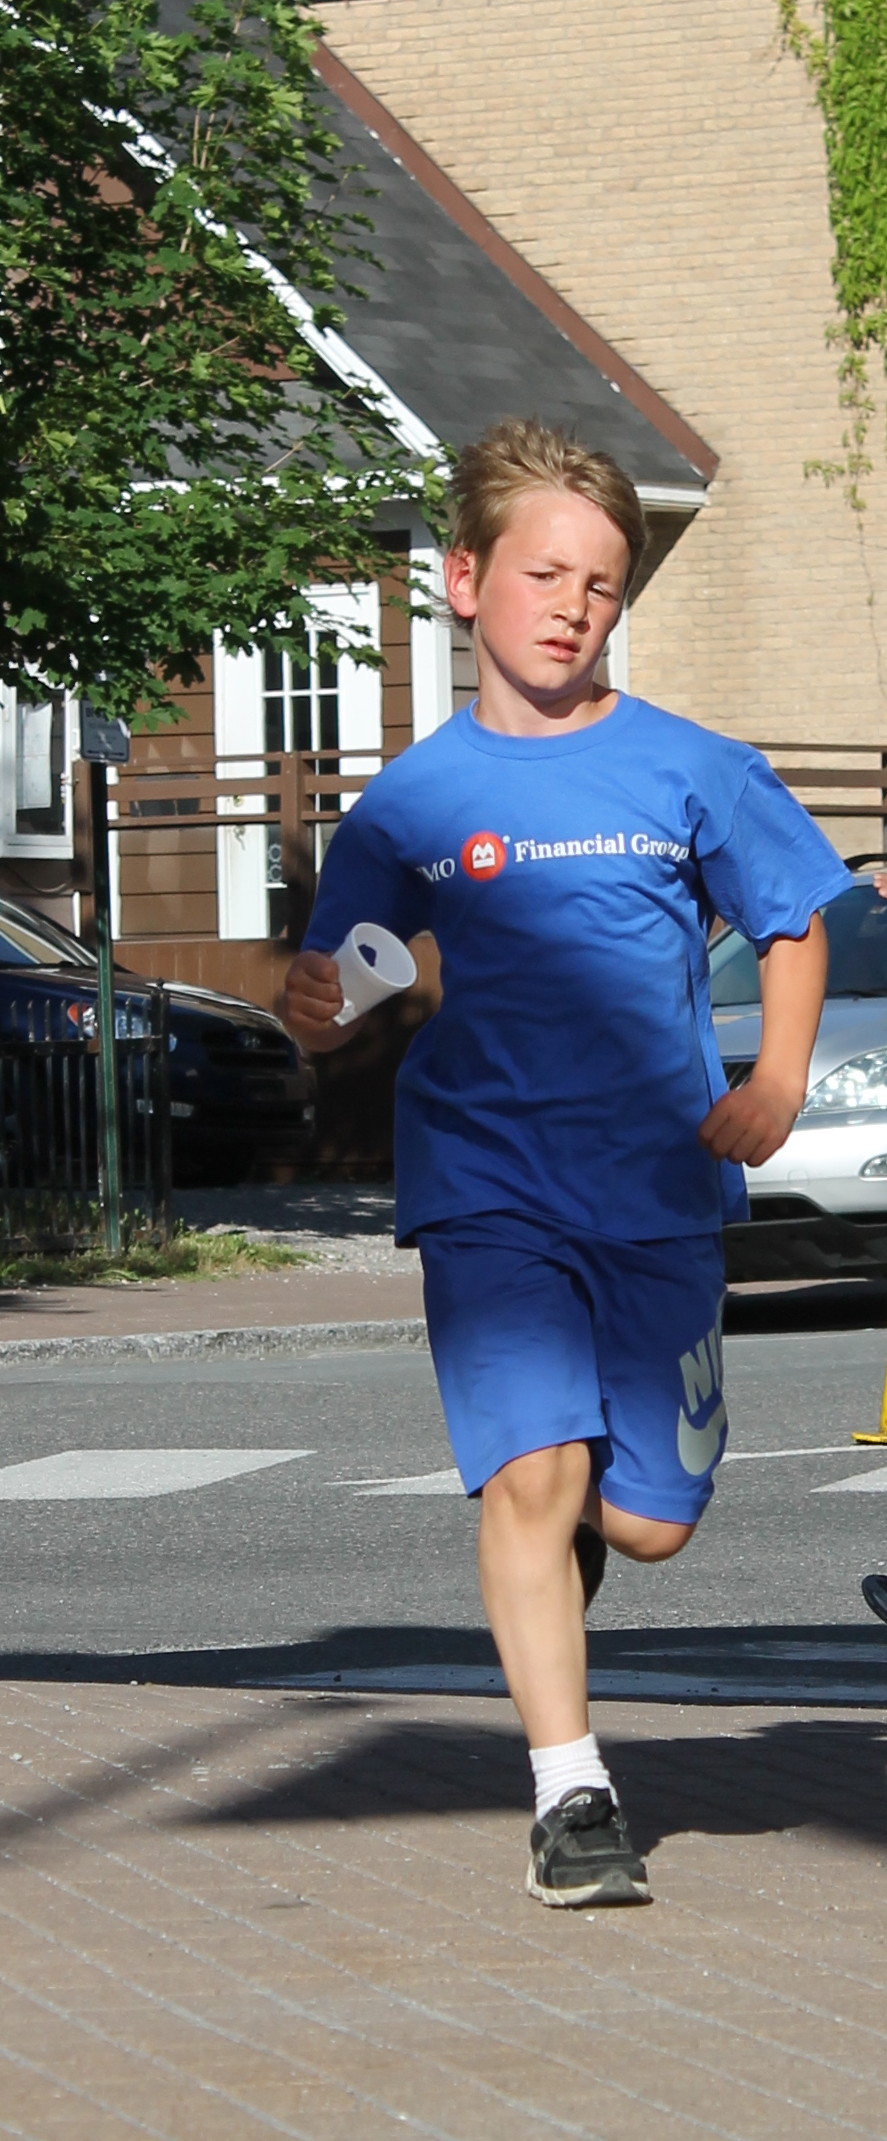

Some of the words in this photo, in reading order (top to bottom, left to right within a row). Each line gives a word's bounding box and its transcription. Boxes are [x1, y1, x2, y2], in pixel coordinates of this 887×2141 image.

[416, 858, 456, 883] MO
[514, 833, 626, 863] Financial
[631, 833, 690, 863] Group
[679, 1293, 725, 1416] NI
